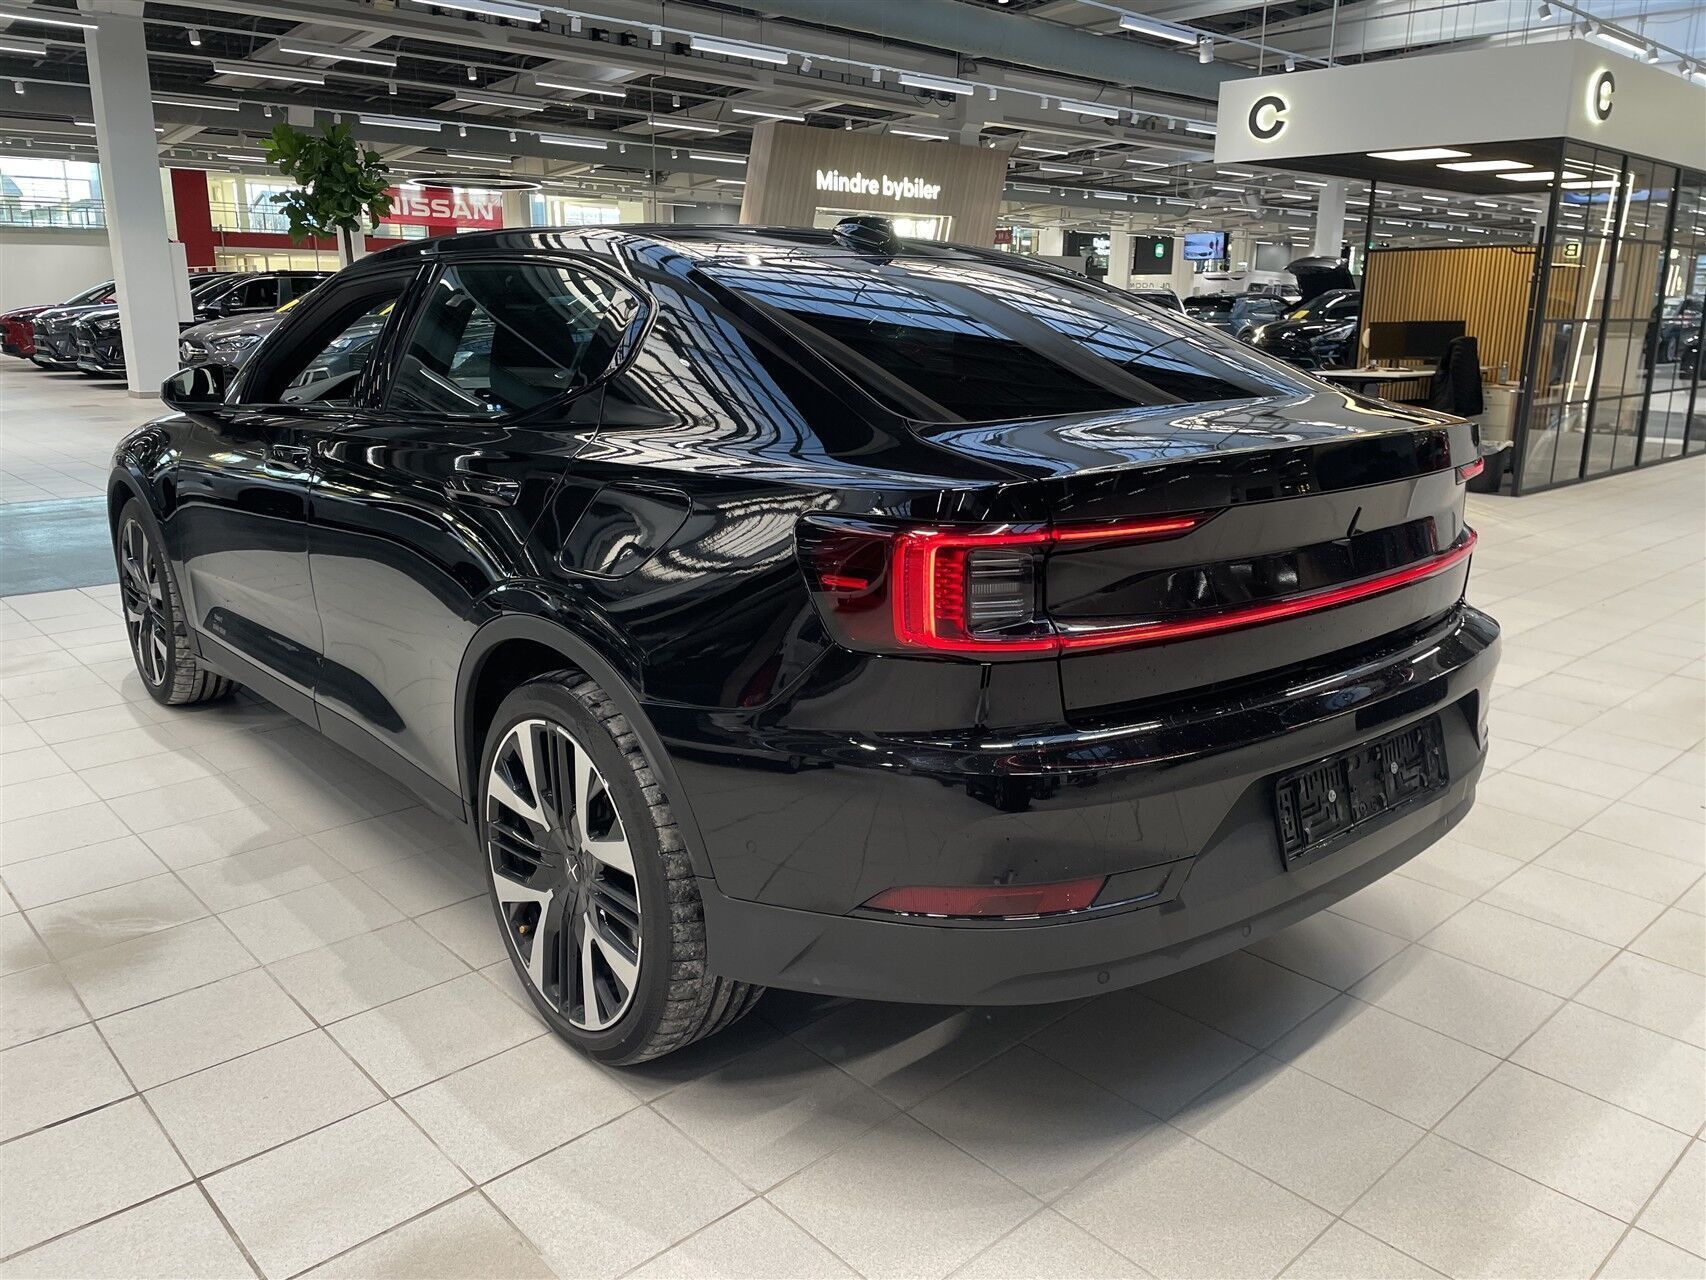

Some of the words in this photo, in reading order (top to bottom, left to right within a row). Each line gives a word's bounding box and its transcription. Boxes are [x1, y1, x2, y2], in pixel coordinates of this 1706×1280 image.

[1248, 95, 1287, 140] C
[1594, 70, 1616, 121] C
[816, 169, 880, 195] Mindre
[882, 174, 941, 201] bybiler
